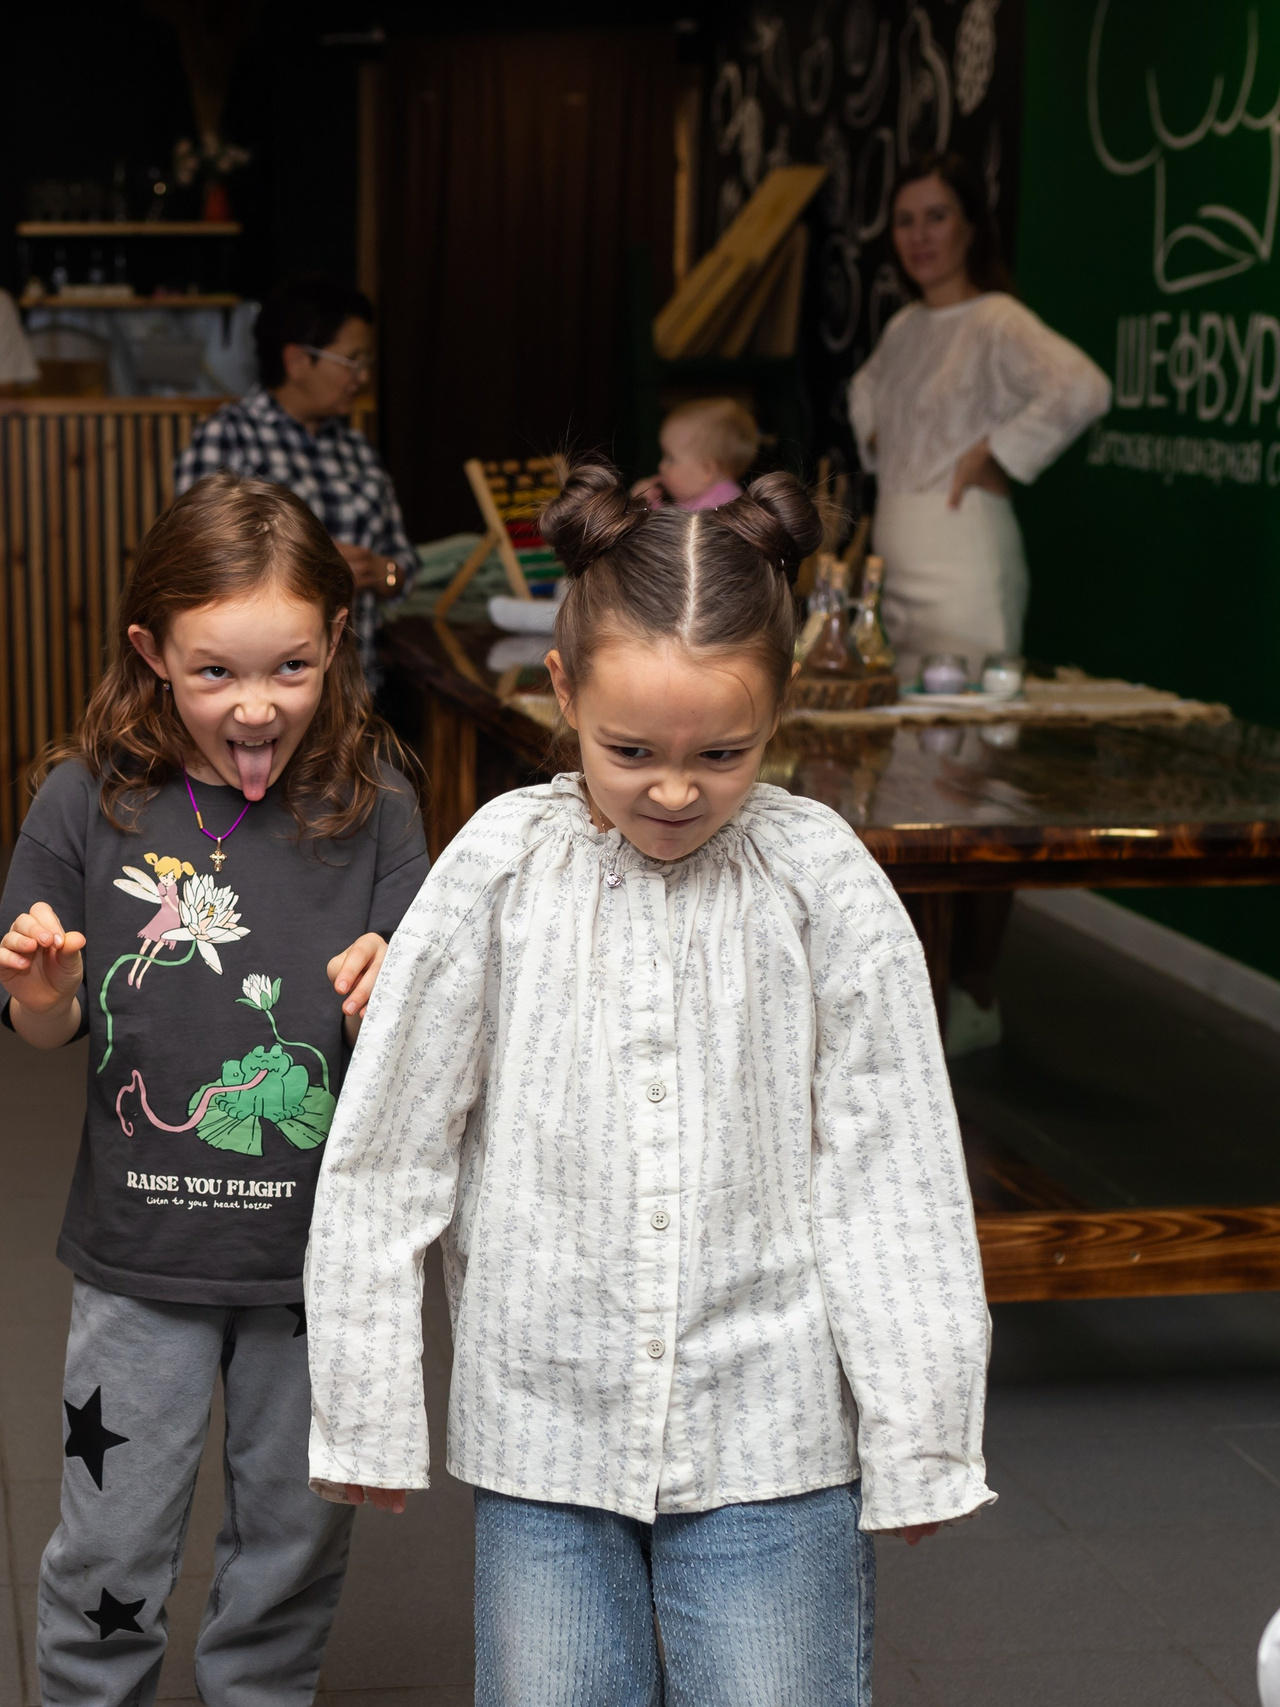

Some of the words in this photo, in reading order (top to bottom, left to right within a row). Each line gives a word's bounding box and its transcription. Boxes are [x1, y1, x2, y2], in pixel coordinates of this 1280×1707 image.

[1116, 310, 1280, 427] ШЕФВУР
[127, 1171, 179, 1192] RAISE
[184, 1177, 222, 1195] YOU
[227, 1180, 296, 1198] FLIGHT
[171, 1196, 184, 1205] to
[213, 1199, 240, 1209] heart
